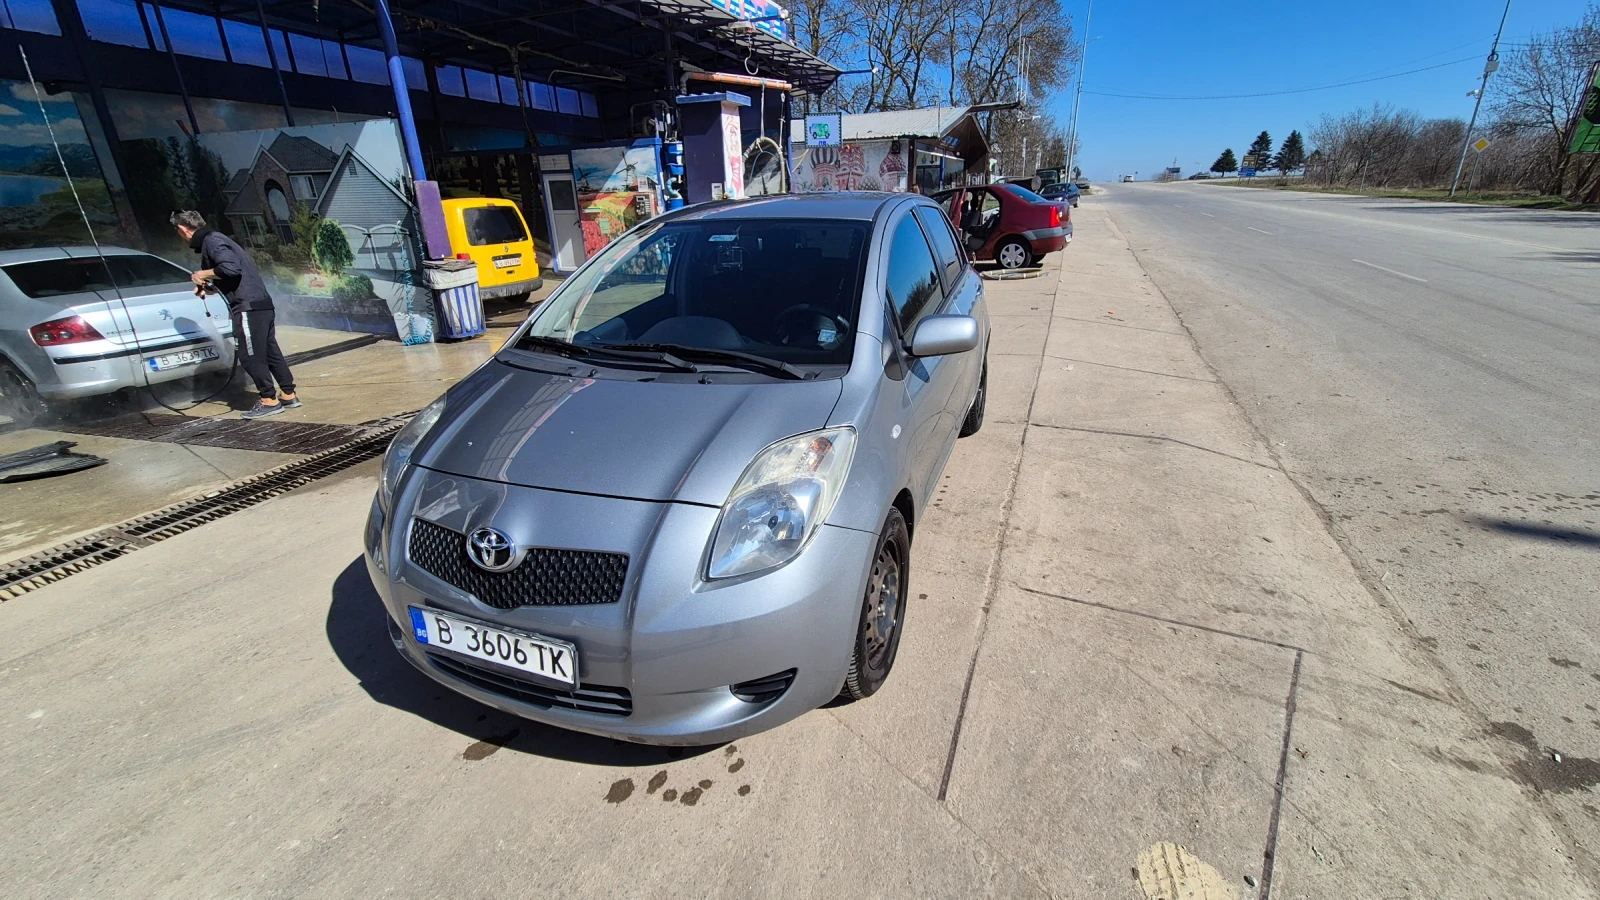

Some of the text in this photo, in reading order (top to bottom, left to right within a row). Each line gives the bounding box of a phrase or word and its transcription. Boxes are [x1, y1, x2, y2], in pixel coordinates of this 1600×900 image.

[161, 347, 216, 365] B 3639 TK
[416, 628, 427, 638] BG
[435, 617, 568, 677] B 3606 TK
